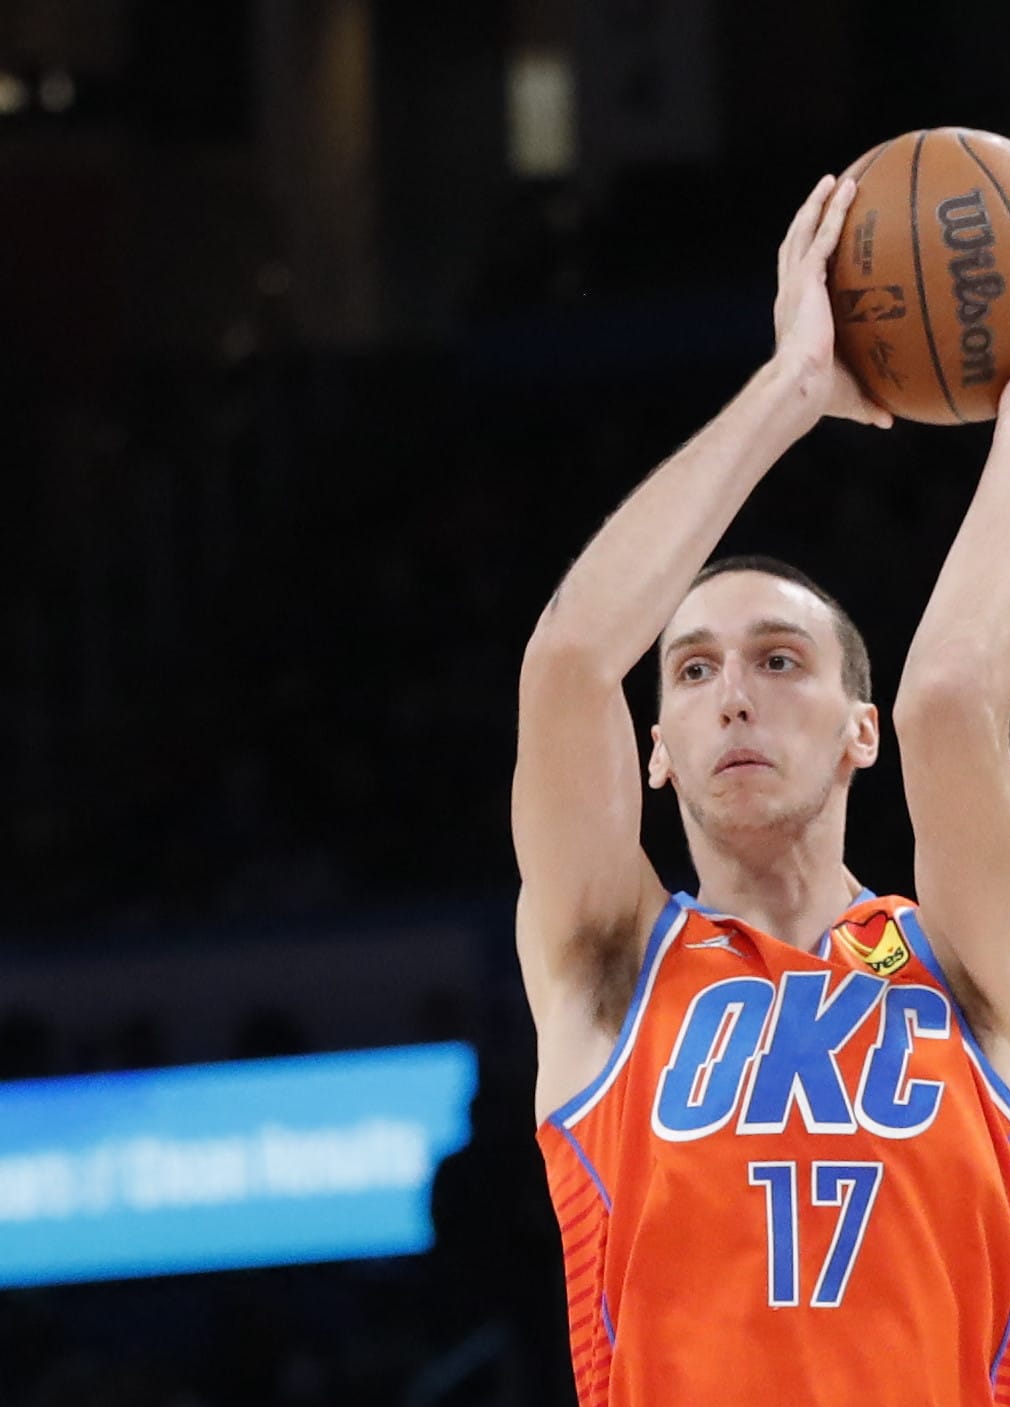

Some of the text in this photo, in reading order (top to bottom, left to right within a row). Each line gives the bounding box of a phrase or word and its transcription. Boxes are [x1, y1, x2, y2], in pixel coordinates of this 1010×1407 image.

[936, 187, 1004, 388] Wilson
[651, 970, 951, 1142] OKC
[748, 1160, 884, 1308] 17
